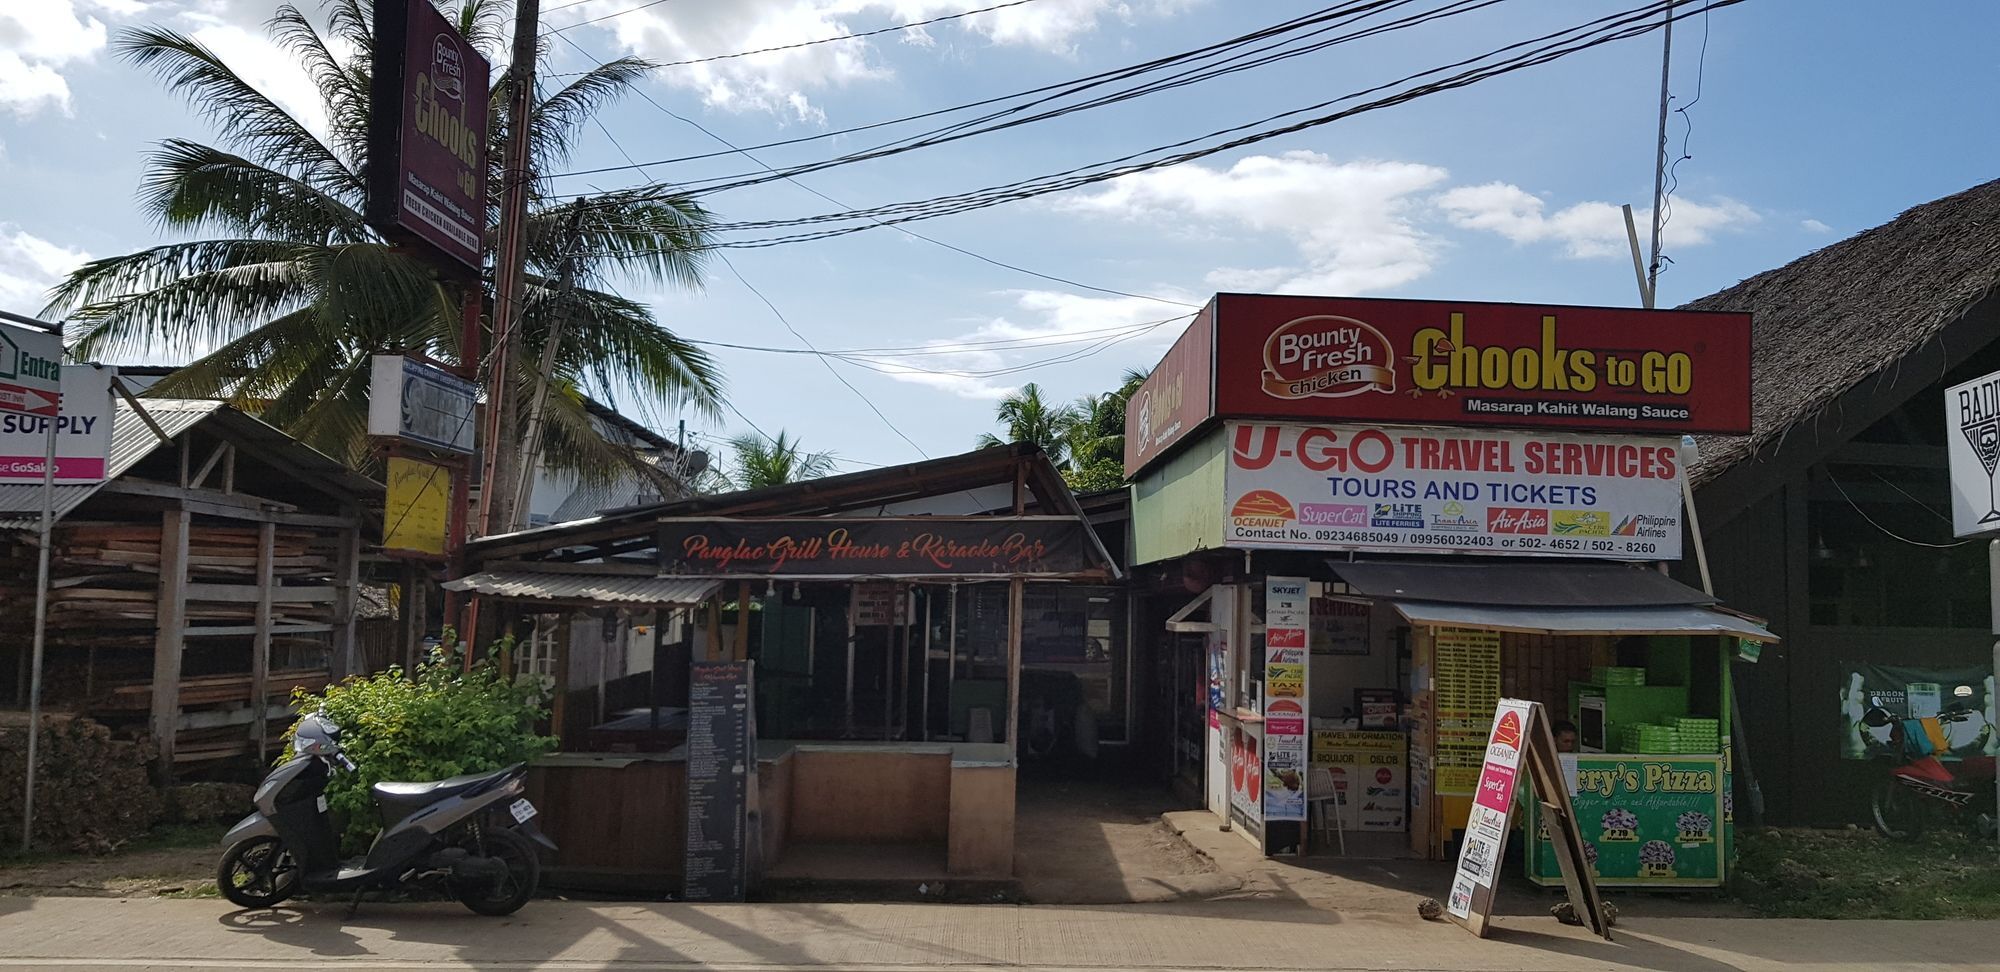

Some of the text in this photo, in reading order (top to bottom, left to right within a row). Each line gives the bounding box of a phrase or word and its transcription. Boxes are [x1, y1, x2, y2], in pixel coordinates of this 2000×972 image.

[437, 42, 458, 65] Bounty
[464, 170, 475, 200] GO
[405, 194, 477, 250] FRESH CHICKEN AVAILABLE HERE
[1279, 327, 1361, 364] Bounty
[1412, 313, 1692, 395] Chooks to GO
[20, 352, 60, 382] Entra
[1289, 368, 1362, 395] chicken
[1468, 400, 1689, 419] Masarap Kahit Walang Sauce
[3, 415, 97, 435] SUPPLY
[1232, 425, 1676, 480] U-GO TRAVEL SERVICES
[11, 462, 59, 473] GoSako
[1327, 477, 1597, 506] TOURS AND TICKETS
[1233, 517, 1287, 528] OCEANJET
[1301, 505, 1366, 525] SuperCat
[1637, 514, 1676, 528] Philippine
[1236, 527, 1286, 539] Contact
[1290, 530, 1311, 540] No.
[1316, 531, 1398, 543] 09234685049
[1402, 533, 1407, 543] /
[1411, 534, 1494, 546] 09956032403
[1550, 540, 1580, 550] 4652
[1592, 541, 1614, 551] 502
[1627, 542, 1656, 553] 8260
[1636, 526, 1667, 538] Airlines
[683, 528, 1046, 573] Panglao Grill House & Karaoke Bar
[1272, 586, 1301, 594] SKYJET
[1317, 731, 1404, 741] TRAVEL INFORMATION
[1317, 754, 1354, 763] SIQUIJOR
[1370, 755, 1398, 764] OSLOB
[1490, 746, 1516, 761] OCEANJET
[1484, 776, 1506, 793] SuperCat
[1642, 763, 1716, 794] Pizza
[1612, 795, 1627, 806] Size
[1631, 796, 1643, 806] and
